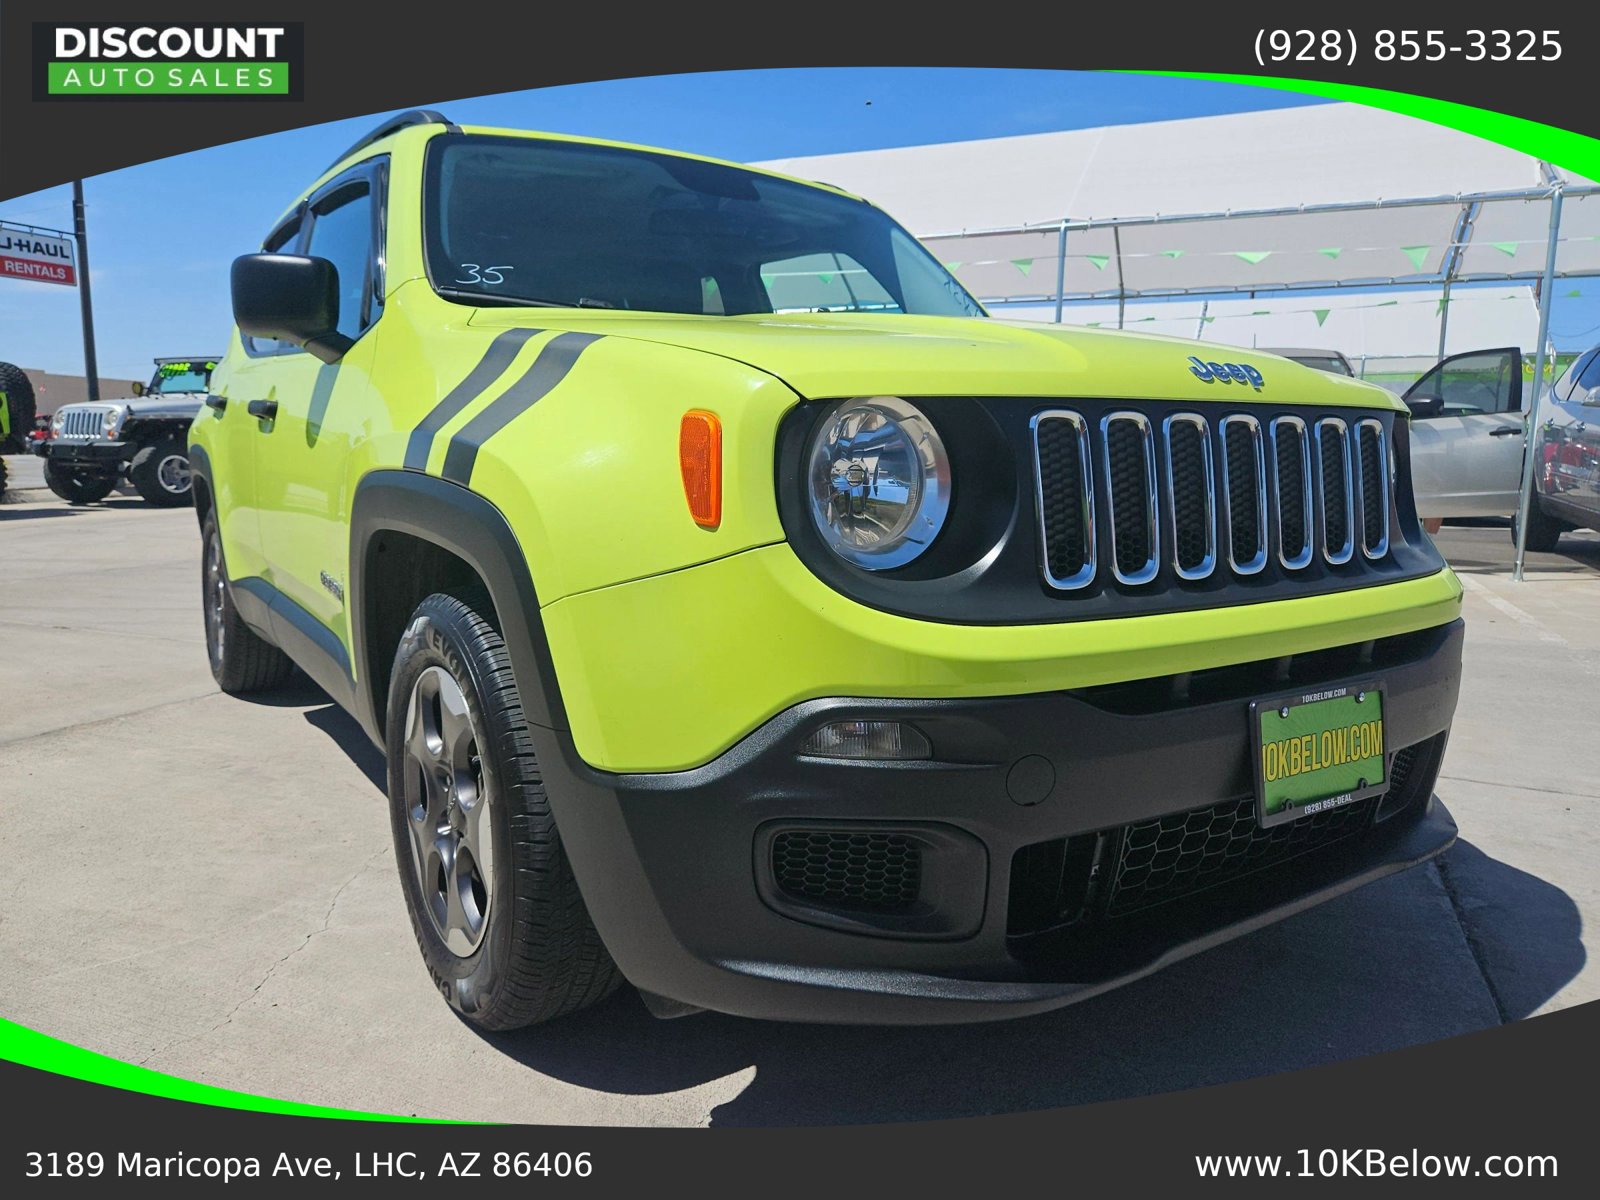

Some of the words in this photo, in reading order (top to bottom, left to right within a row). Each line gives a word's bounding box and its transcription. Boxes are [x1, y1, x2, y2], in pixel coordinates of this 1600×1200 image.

[4, 260, 66, 280] RENTALS
[455, 263, 514, 284] 35
[1187, 356, 1263, 388] Jeep
[1302, 687, 1347, 703] 10KBELOW.COM
